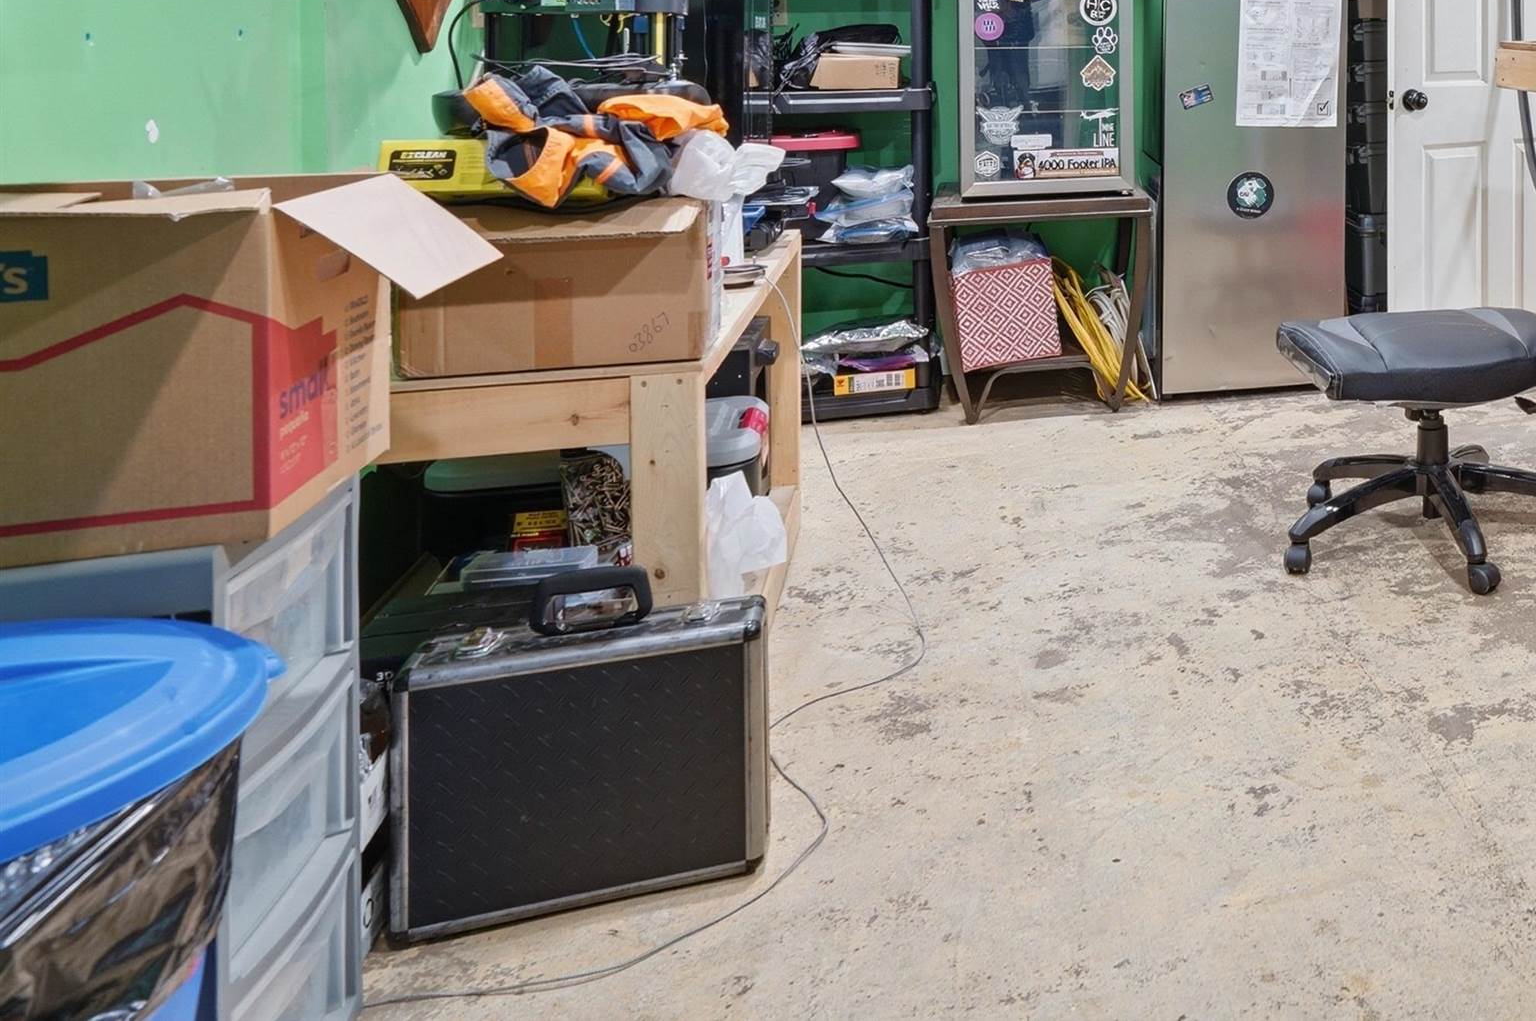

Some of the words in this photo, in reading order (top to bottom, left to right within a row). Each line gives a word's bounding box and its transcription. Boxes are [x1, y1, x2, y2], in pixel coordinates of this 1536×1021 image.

[1038, 159, 1065, 171] 4000
[1067, 158, 1100, 170] Footer
[1101, 157, 1117, 169] IPA
